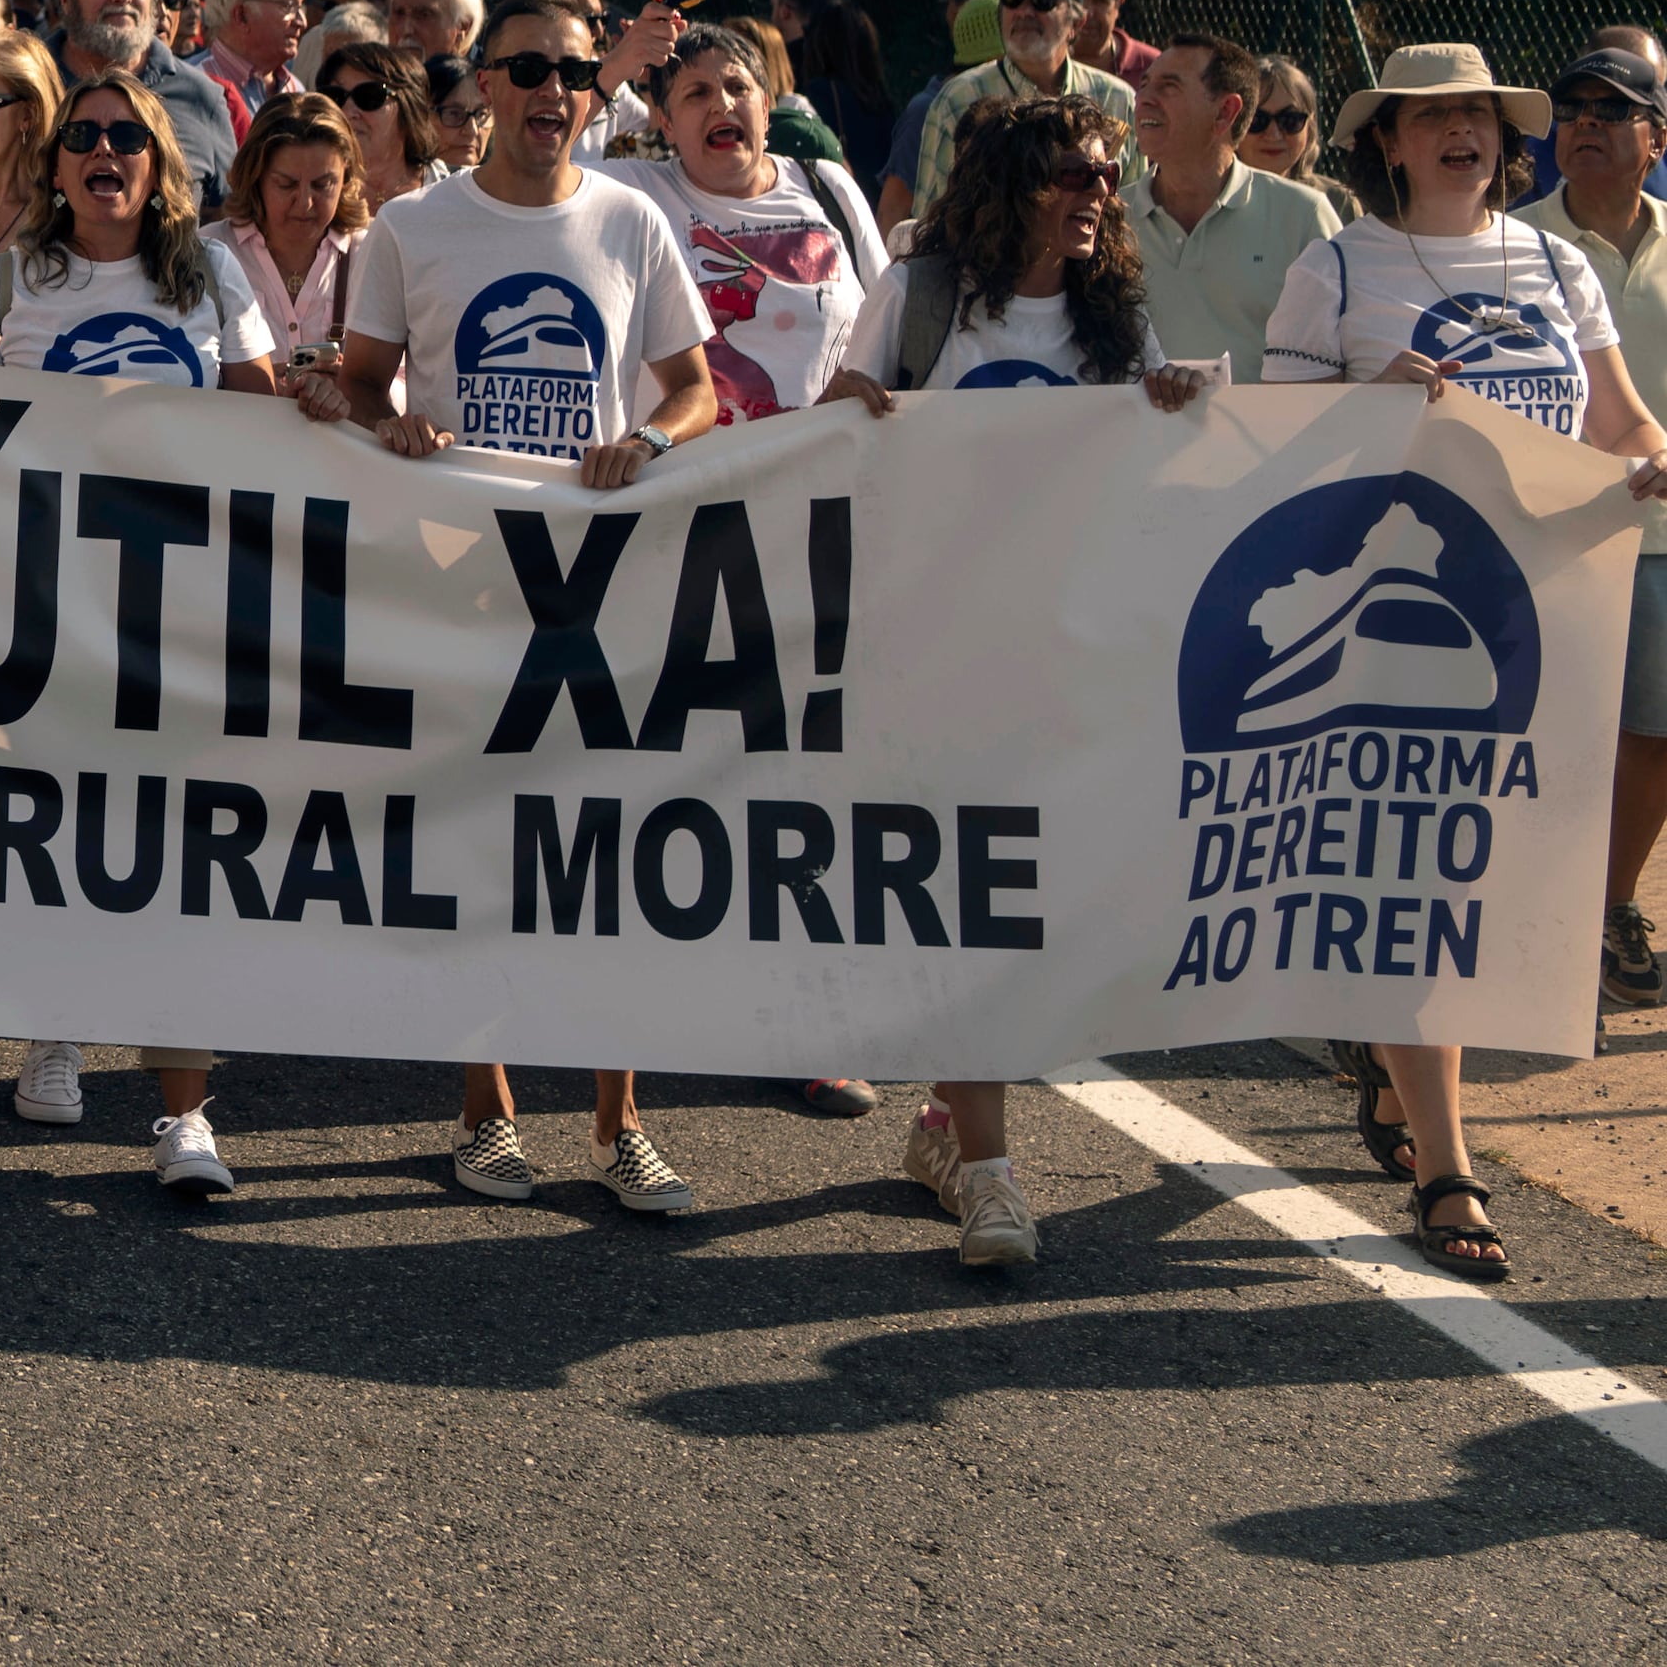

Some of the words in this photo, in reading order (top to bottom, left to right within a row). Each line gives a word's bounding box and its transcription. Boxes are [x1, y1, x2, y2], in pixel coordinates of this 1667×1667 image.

[456, 375, 598, 406] PLATAFORM
[463, 402, 594, 441] DEREITO
[482, 496, 852, 755] XA!
[1178, 731, 1540, 819] PLATAFORMA
[511, 793, 1044, 951] MORRE
[1187, 798, 1493, 902] DEREITO
[1161, 906, 1257, 991] AO
[1273, 892, 1483, 979] TREN
